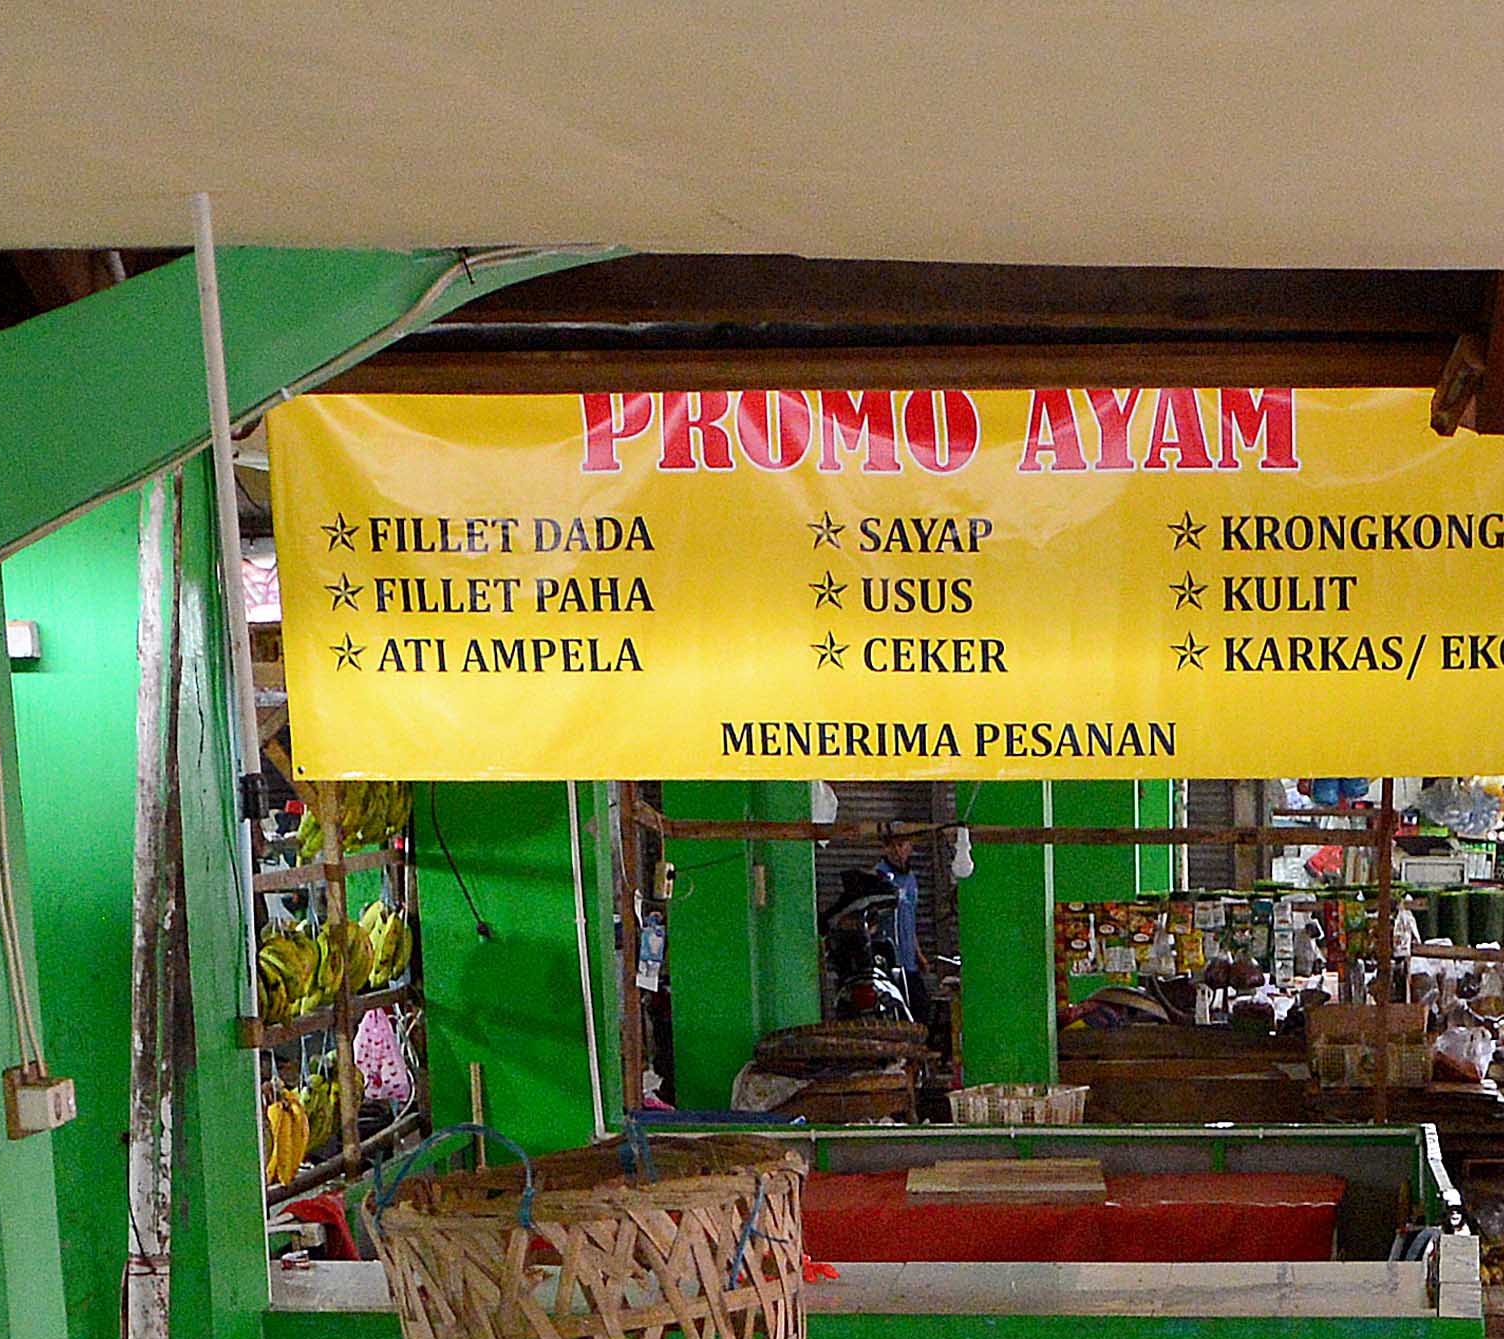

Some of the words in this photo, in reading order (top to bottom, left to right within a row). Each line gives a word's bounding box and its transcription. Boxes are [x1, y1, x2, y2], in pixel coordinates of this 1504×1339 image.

[580, 390, 978, 473] PROMO
[1018, 388, 1302, 473] AYAM
[368, 517, 520, 553] FILLET
[533, 516, 655, 552] DADA
[859, 517, 993, 553] SAYAP
[373, 578, 521, 613] FILLET
[536, 577, 655, 613] PAHA
[862, 577, 973, 614] USUS
[1222, 576, 1358, 612] KULIT
[378, 638, 447, 673] ATI
[462, 638, 643, 673] AMPELA
[863, 637, 1008, 673] CEKER
[1224, 634, 1427, 681] KARKAS/
[721, 722, 961, 757] MENERIMA
[975, 722, 1176, 757] PESANAN
